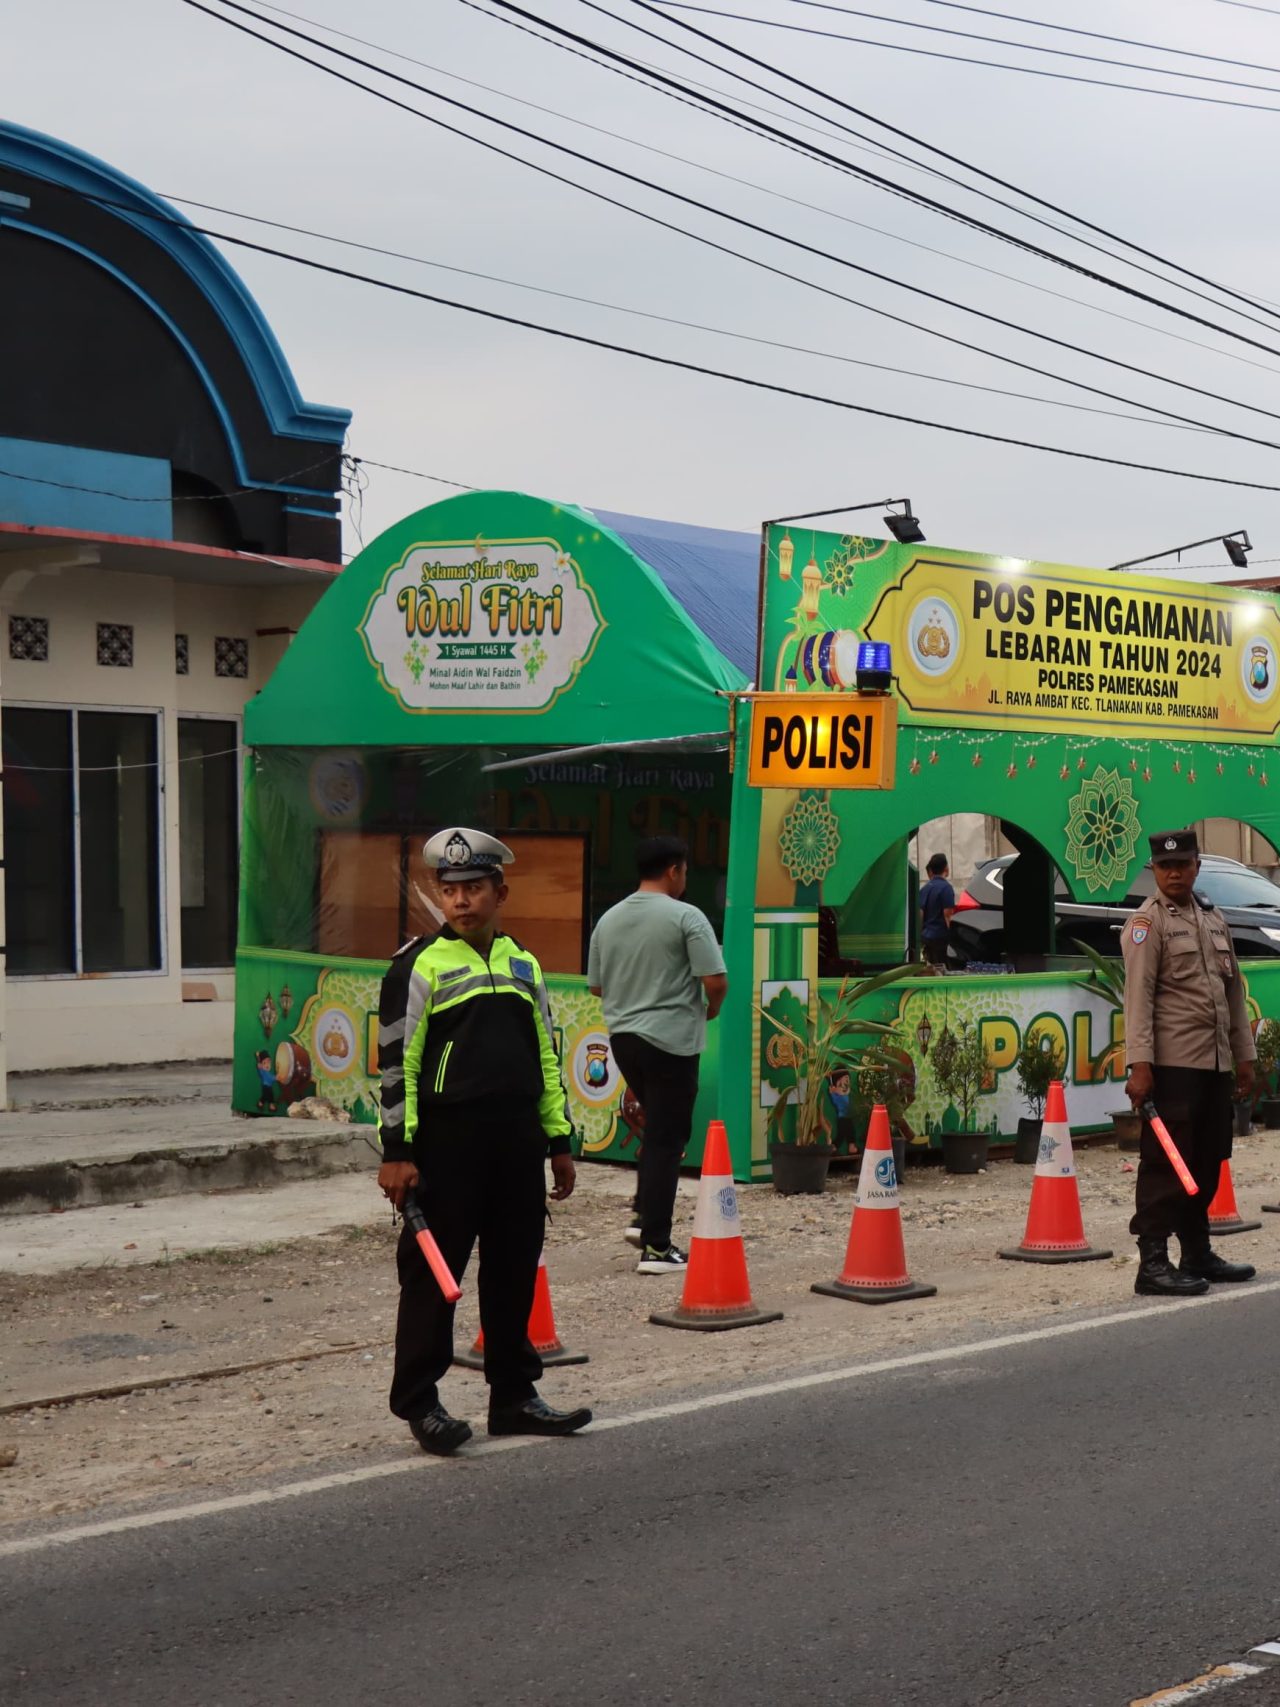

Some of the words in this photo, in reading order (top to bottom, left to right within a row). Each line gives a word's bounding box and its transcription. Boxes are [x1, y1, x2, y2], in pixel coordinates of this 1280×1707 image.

[421, 562, 473, 583] Selamat
[472, 558, 503, 583] Hari
[504, 560, 539, 582] Raya
[397, 582, 473, 638] Idul
[480, 582, 563, 637] Fitri
[972, 579, 1036, 626] POS
[1045, 588, 1233, 647] PENGAMANAN
[451, 645, 477, 658] Syawal
[479, 645, 500, 656] 1445
[500, 645, 507, 655] H
[985, 629, 1092, 667] LEBARAN
[1099, 640, 1170, 674] TAHUN
[1176, 649, 1222, 679] 2024
[429, 668, 451, 678] Minal
[453, 667, 474, 678] Aidin
[475, 667, 491, 678] Wal
[492, 667, 522, 677] Faidzin
[429, 682, 449, 690] Mohon
[450, 682, 467, 690] Maaf
[468, 682, 485, 690] Lahir
[486, 682, 498, 690] dan
[499, 681, 521, 690] Bathin
[1038, 668, 1095, 693] POLRES
[1098, 673, 1179, 699] PAMEKASAN
[988, 689, 1003, 705] JL.
[1006, 690, 1032, 706] RAYA
[1034, 692, 1070, 710] AMBAT
[1071, 695, 1093, 712] KEC.
[1095, 697, 1143, 715] TLANAKAN
[1145, 700, 1166, 717] KAB.
[1167, 702, 1219, 720] PAMEKASAN
[761, 713, 874, 770] POLISI
[977, 1009, 1131, 1095] POLI
[867, 1191, 884, 1199] JASA
